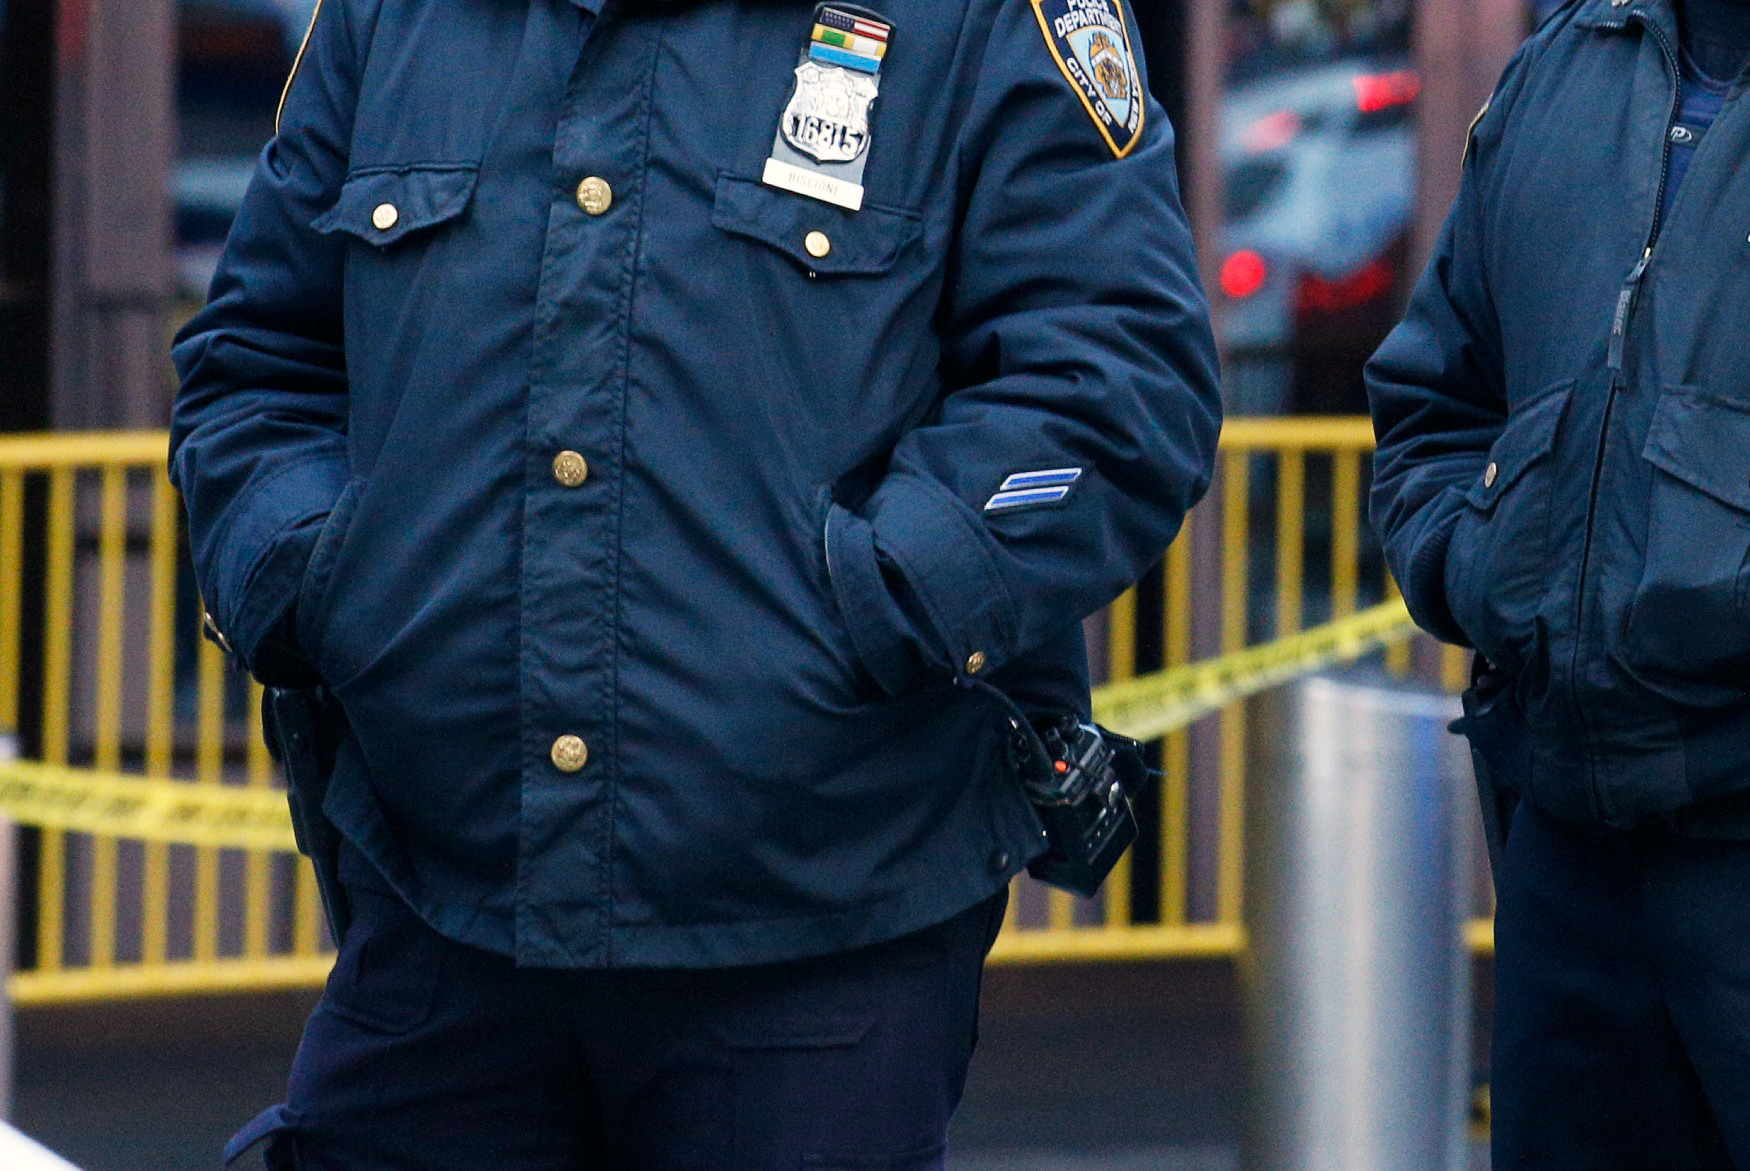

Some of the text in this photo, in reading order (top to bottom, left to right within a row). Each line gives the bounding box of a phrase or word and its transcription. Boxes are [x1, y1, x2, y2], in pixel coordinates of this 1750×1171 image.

[1066, 57, 1113, 126] CITY OF
[793, 115, 862, 156] 16815
